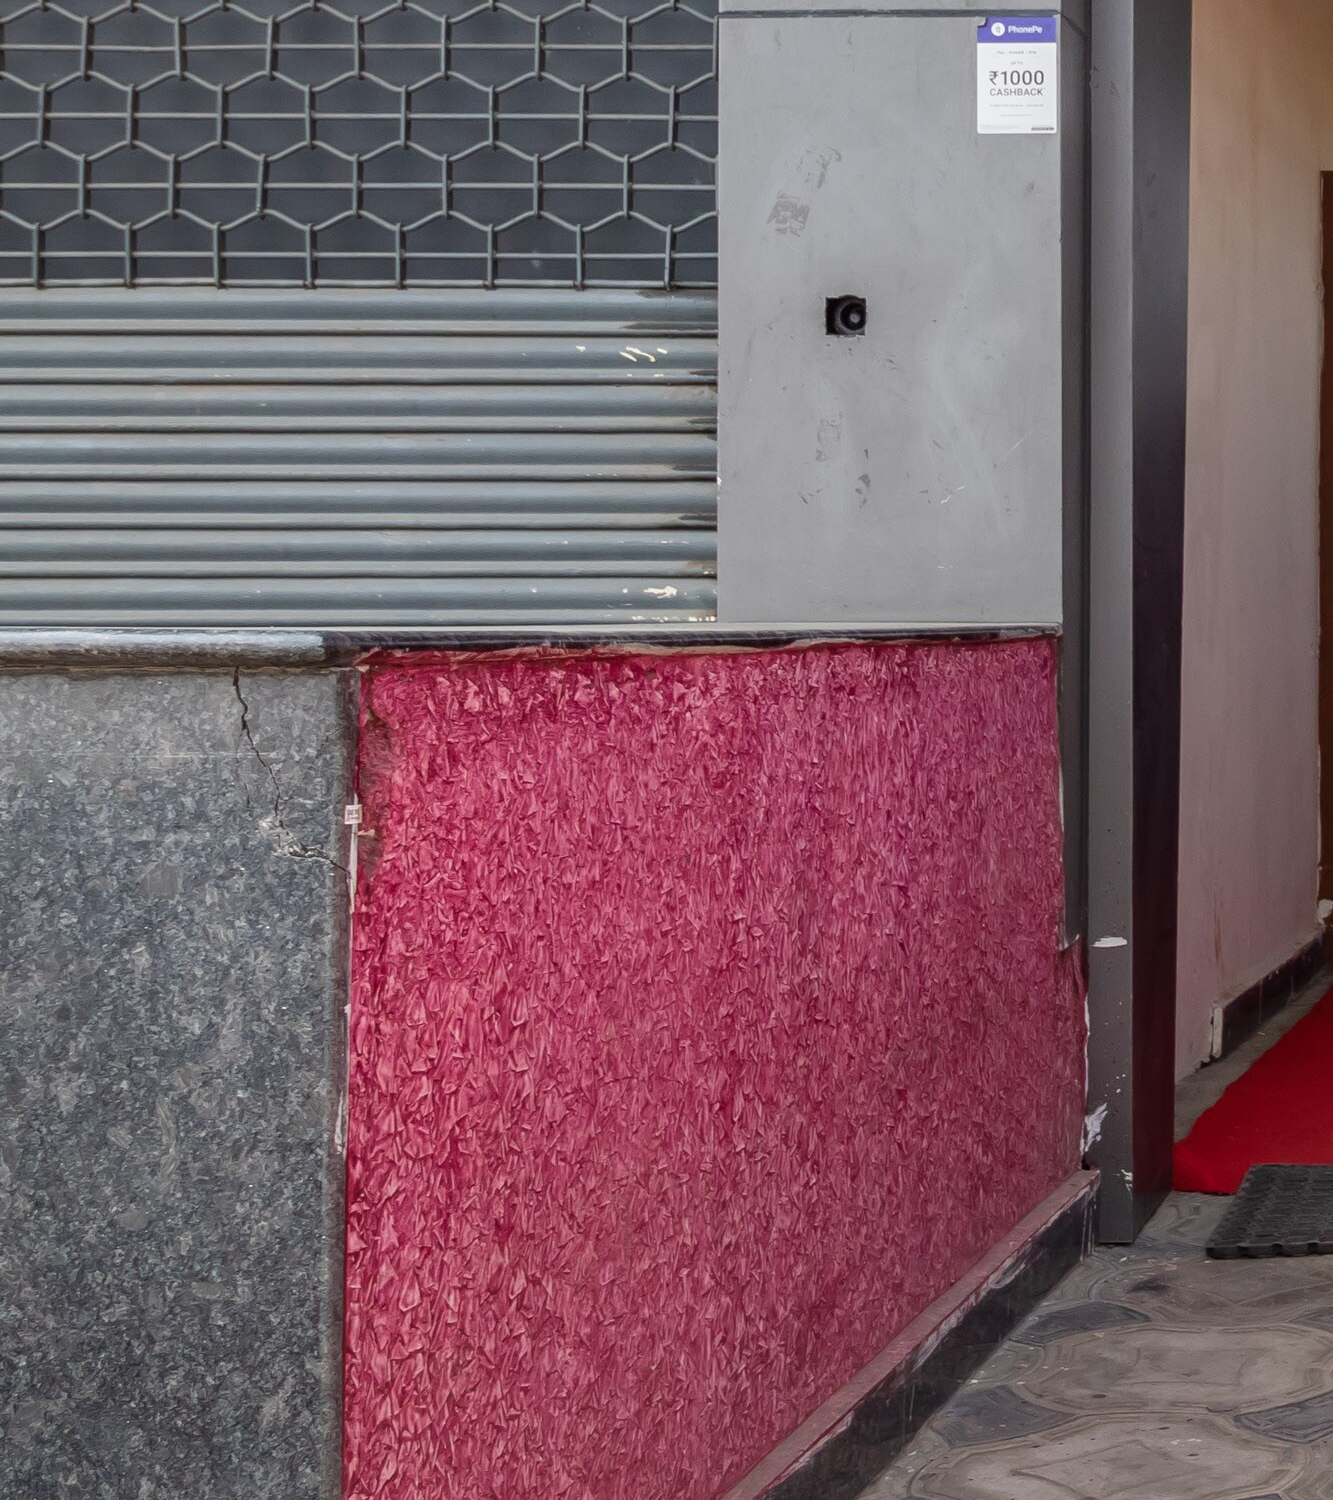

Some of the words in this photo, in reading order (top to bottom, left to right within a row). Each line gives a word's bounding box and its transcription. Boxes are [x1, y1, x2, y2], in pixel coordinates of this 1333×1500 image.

[1008, 25, 1043, 34] PhonePe
[988, 70, 1045, 86] ₹1000
[989, 87, 1044, 97] CASHBACK
